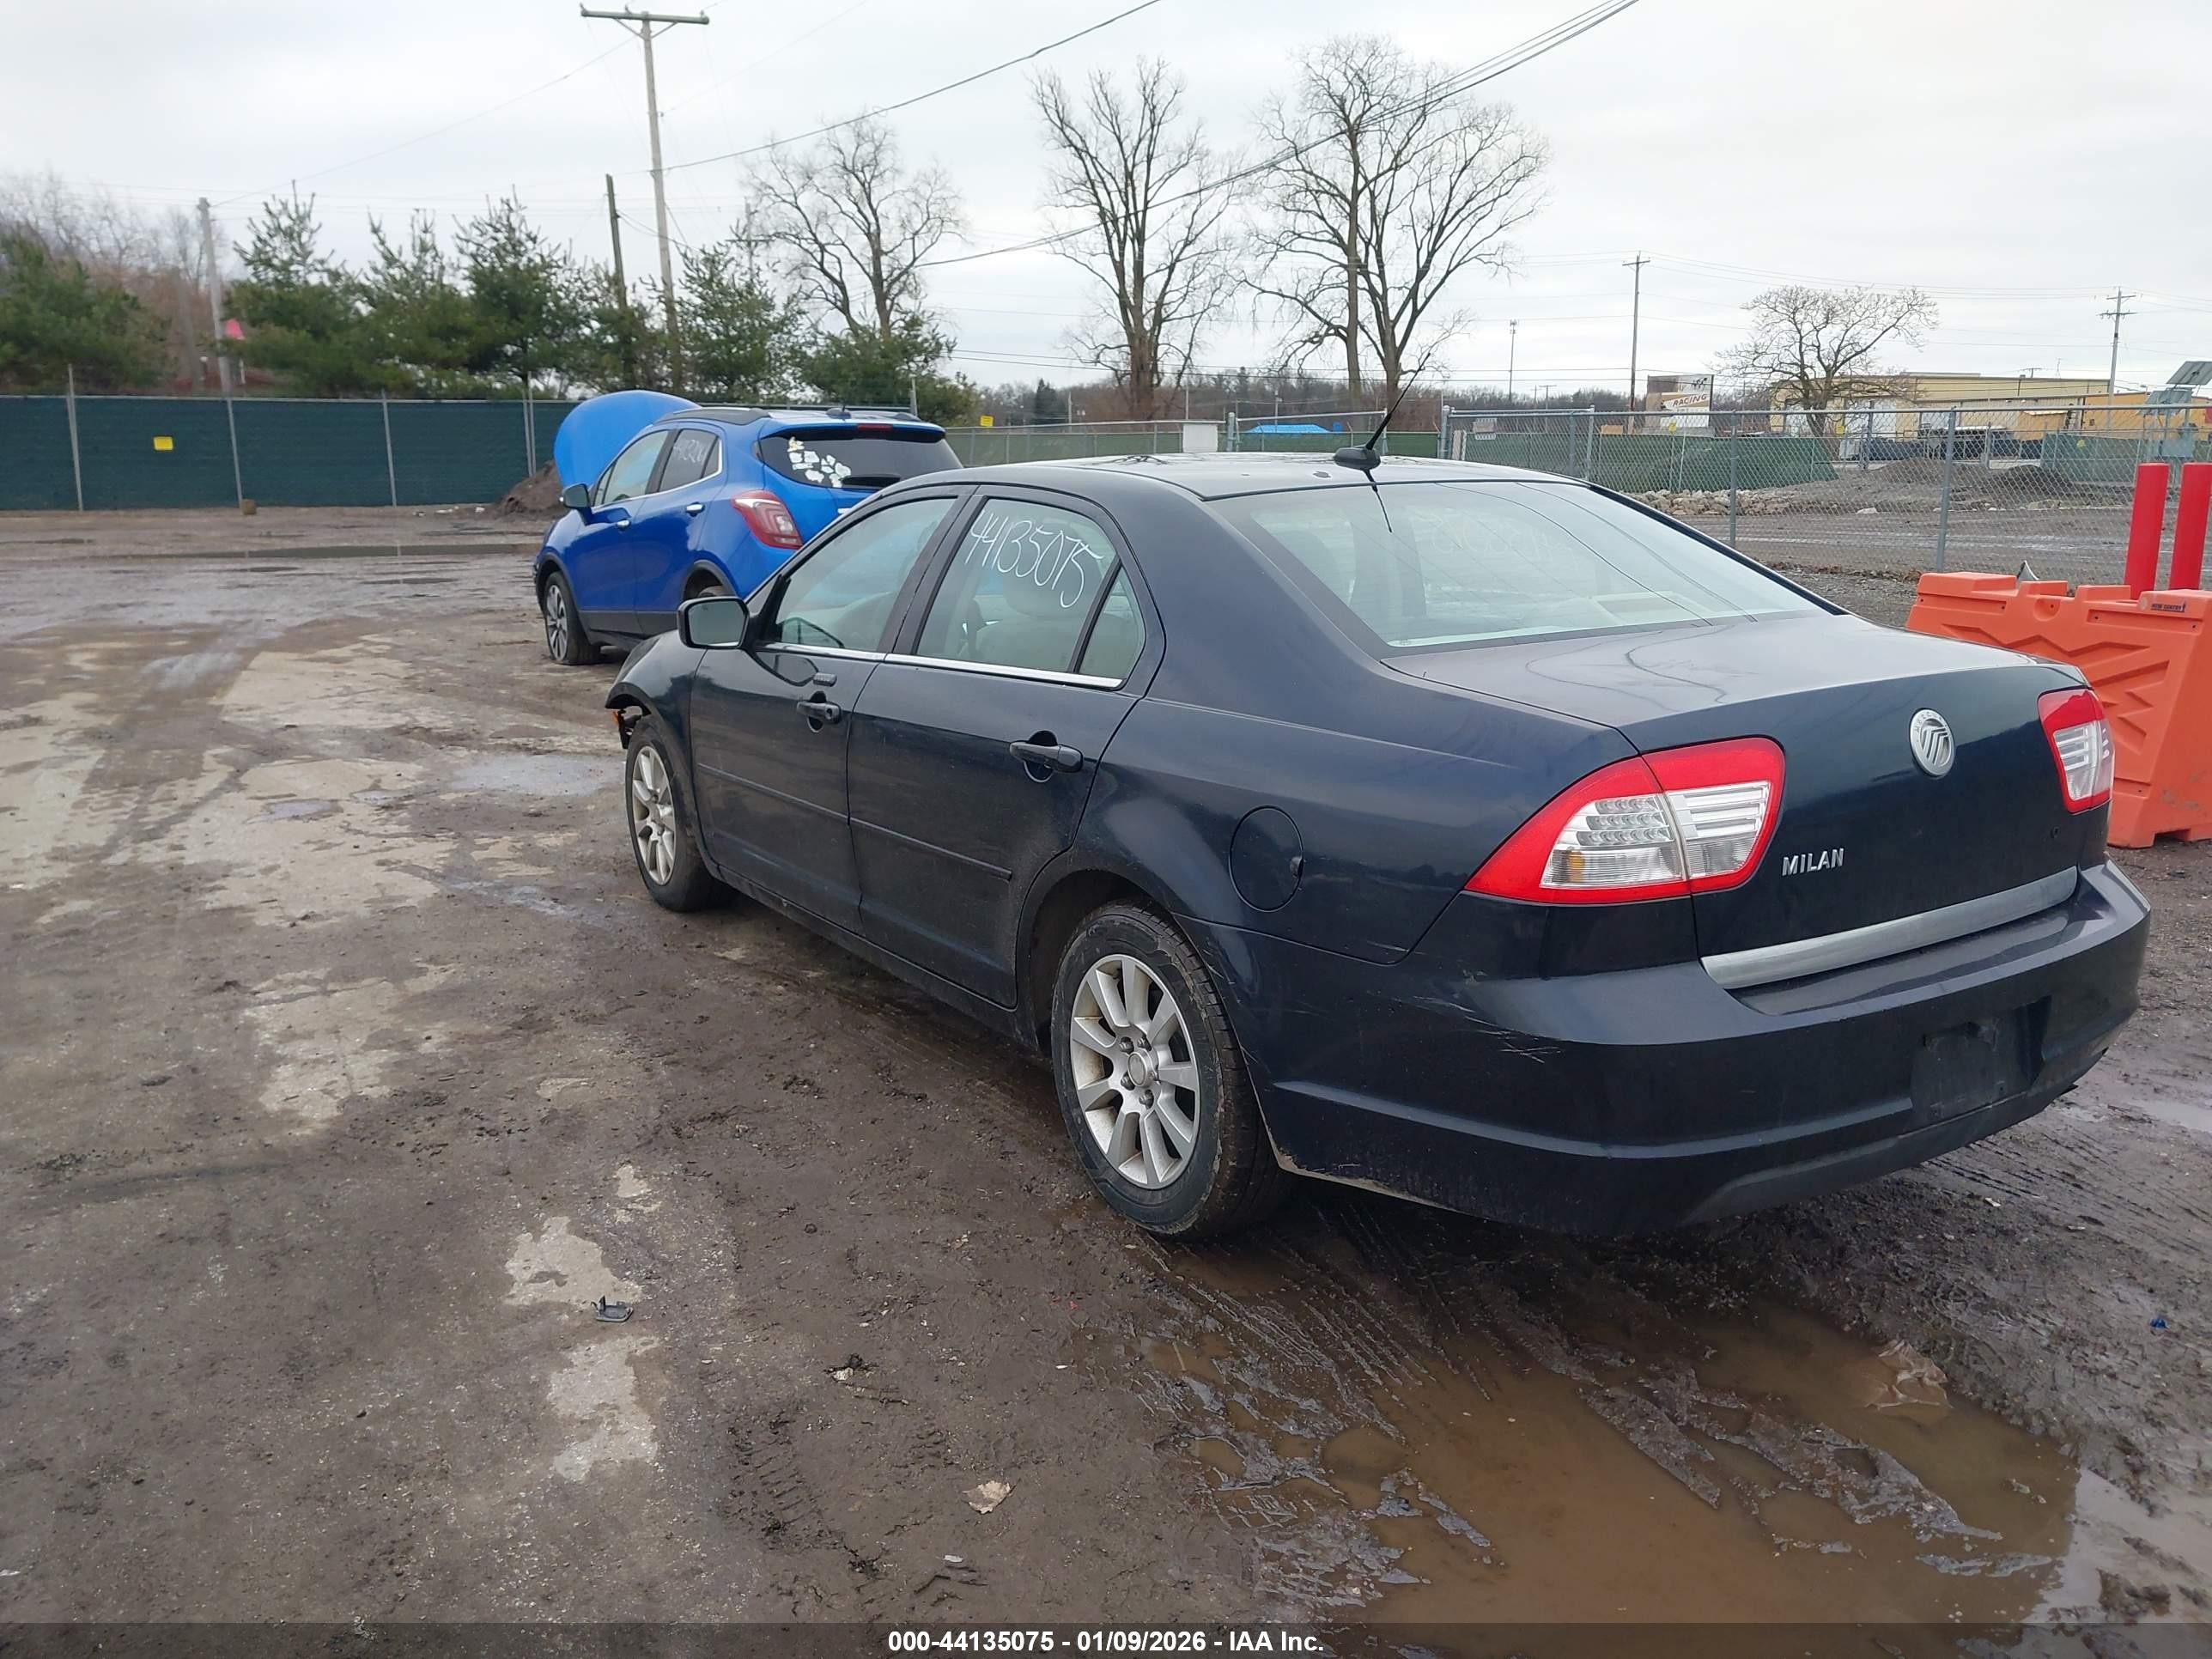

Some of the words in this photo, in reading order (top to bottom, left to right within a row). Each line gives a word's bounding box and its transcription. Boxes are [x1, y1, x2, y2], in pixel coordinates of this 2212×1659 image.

[1673, 394, 1707, 407] RACING
[965, 509, 1104, 608] 44135075
[1782, 848, 1844, 877] MILAN
